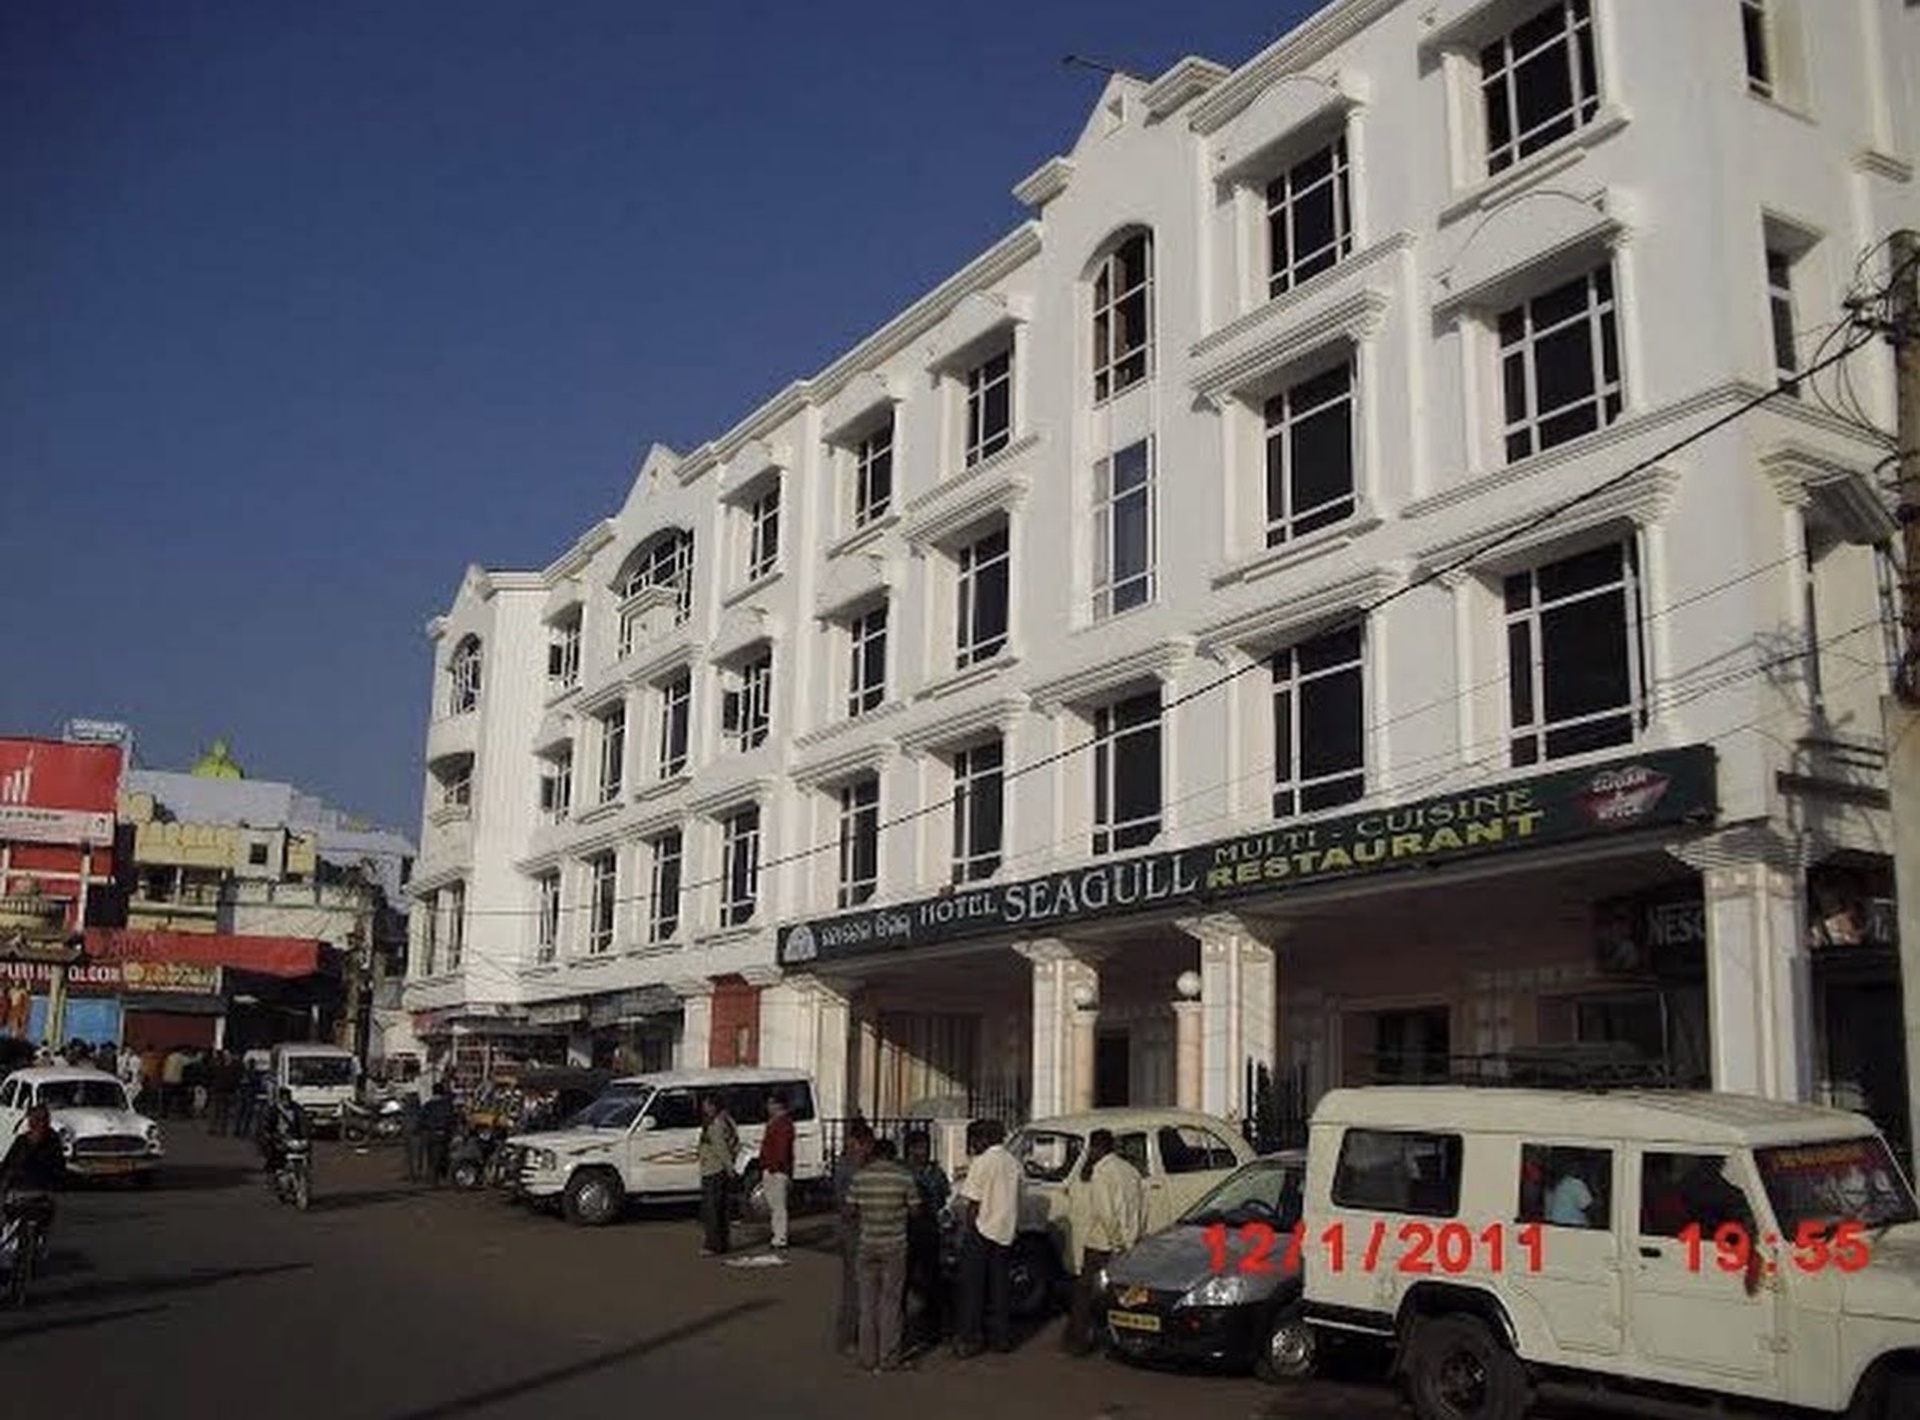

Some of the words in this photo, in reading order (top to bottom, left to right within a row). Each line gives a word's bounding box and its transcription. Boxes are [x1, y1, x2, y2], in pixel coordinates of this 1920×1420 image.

[1206, 809, 1545, 889] RESTAURANT
[1214, 830, 1318, 865] MULTI
[1356, 787, 1534, 837] CUISINE
[920, 893, 998, 926] HOTEL
[1003, 853, 1199, 923] SEAGULL
